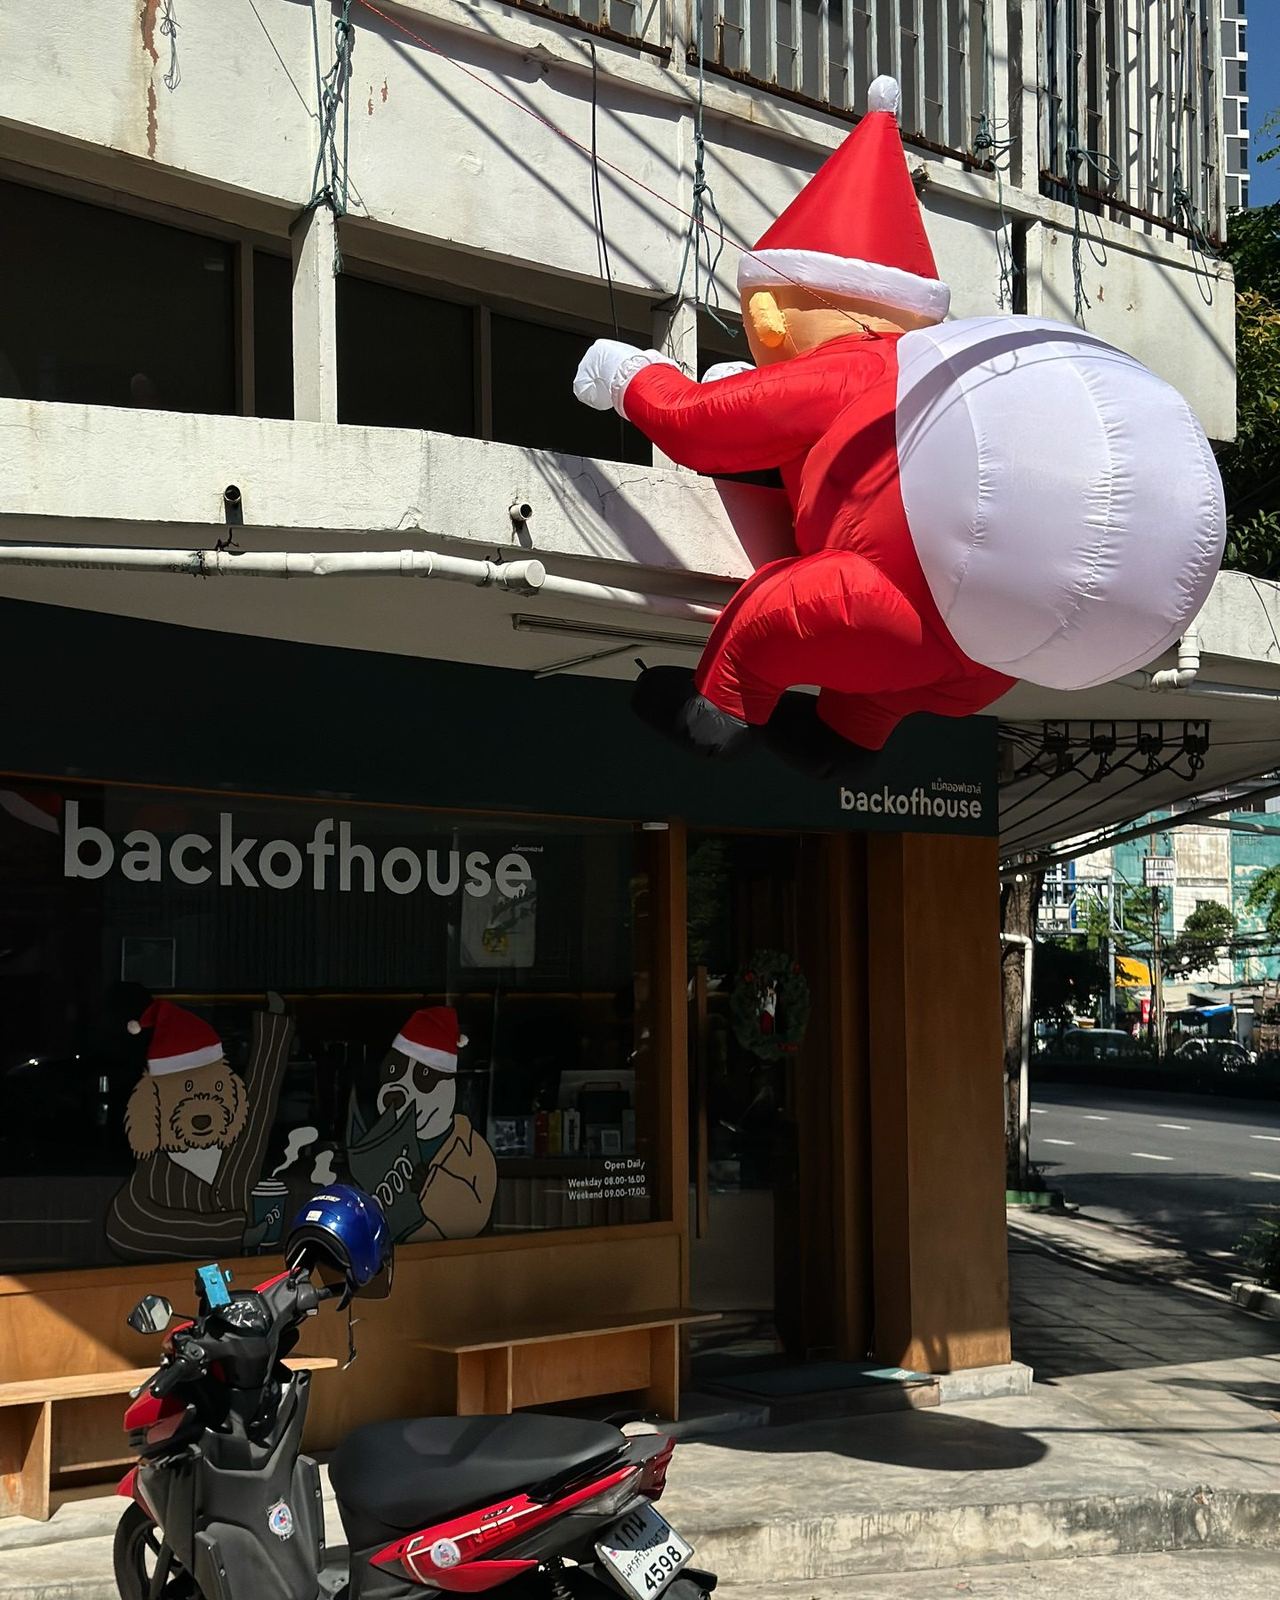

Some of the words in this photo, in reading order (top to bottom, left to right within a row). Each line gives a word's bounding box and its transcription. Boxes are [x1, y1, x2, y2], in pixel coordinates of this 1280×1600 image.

[840, 785, 983, 819] backofhouse
[64, 800, 532, 899] backofhouse
[604, 1160, 626, 1172] Open
[568, 1177, 602, 1188] Weekday
[568, 1189, 603, 1200] Weekend
[604, 1187, 646, 1198] 09.00-17.00
[644, 1545, 682, 1591] 4598
